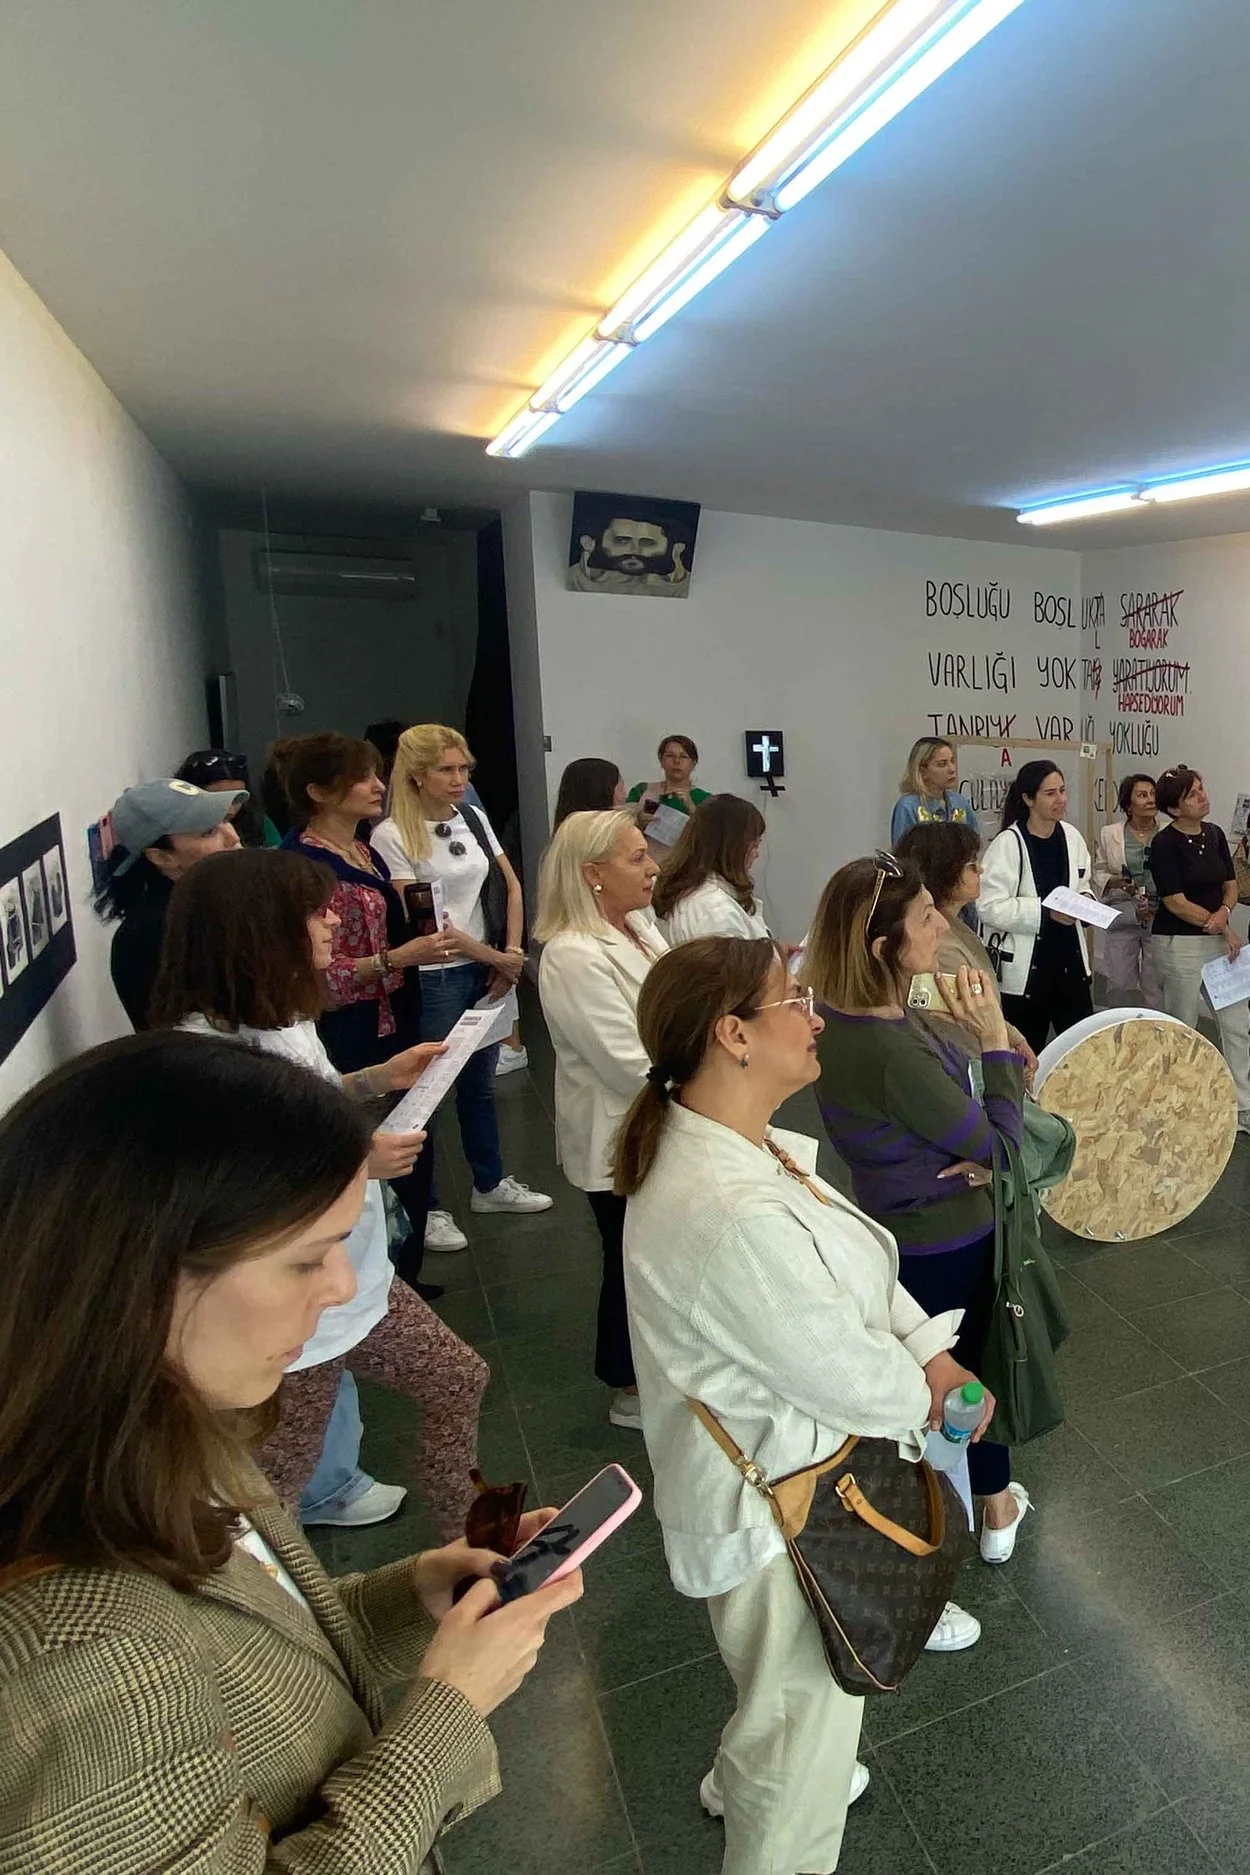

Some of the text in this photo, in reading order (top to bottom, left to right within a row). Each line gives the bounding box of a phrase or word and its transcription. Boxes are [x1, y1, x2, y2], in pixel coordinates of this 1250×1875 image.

[926, 580, 1010, 621] BOŞLUĞU
[928, 652, 1016, 694] VARLIĞI
[1001, 748, 1012, 767] A
[1109, 720, 1159, 758] YOKLUĞU
